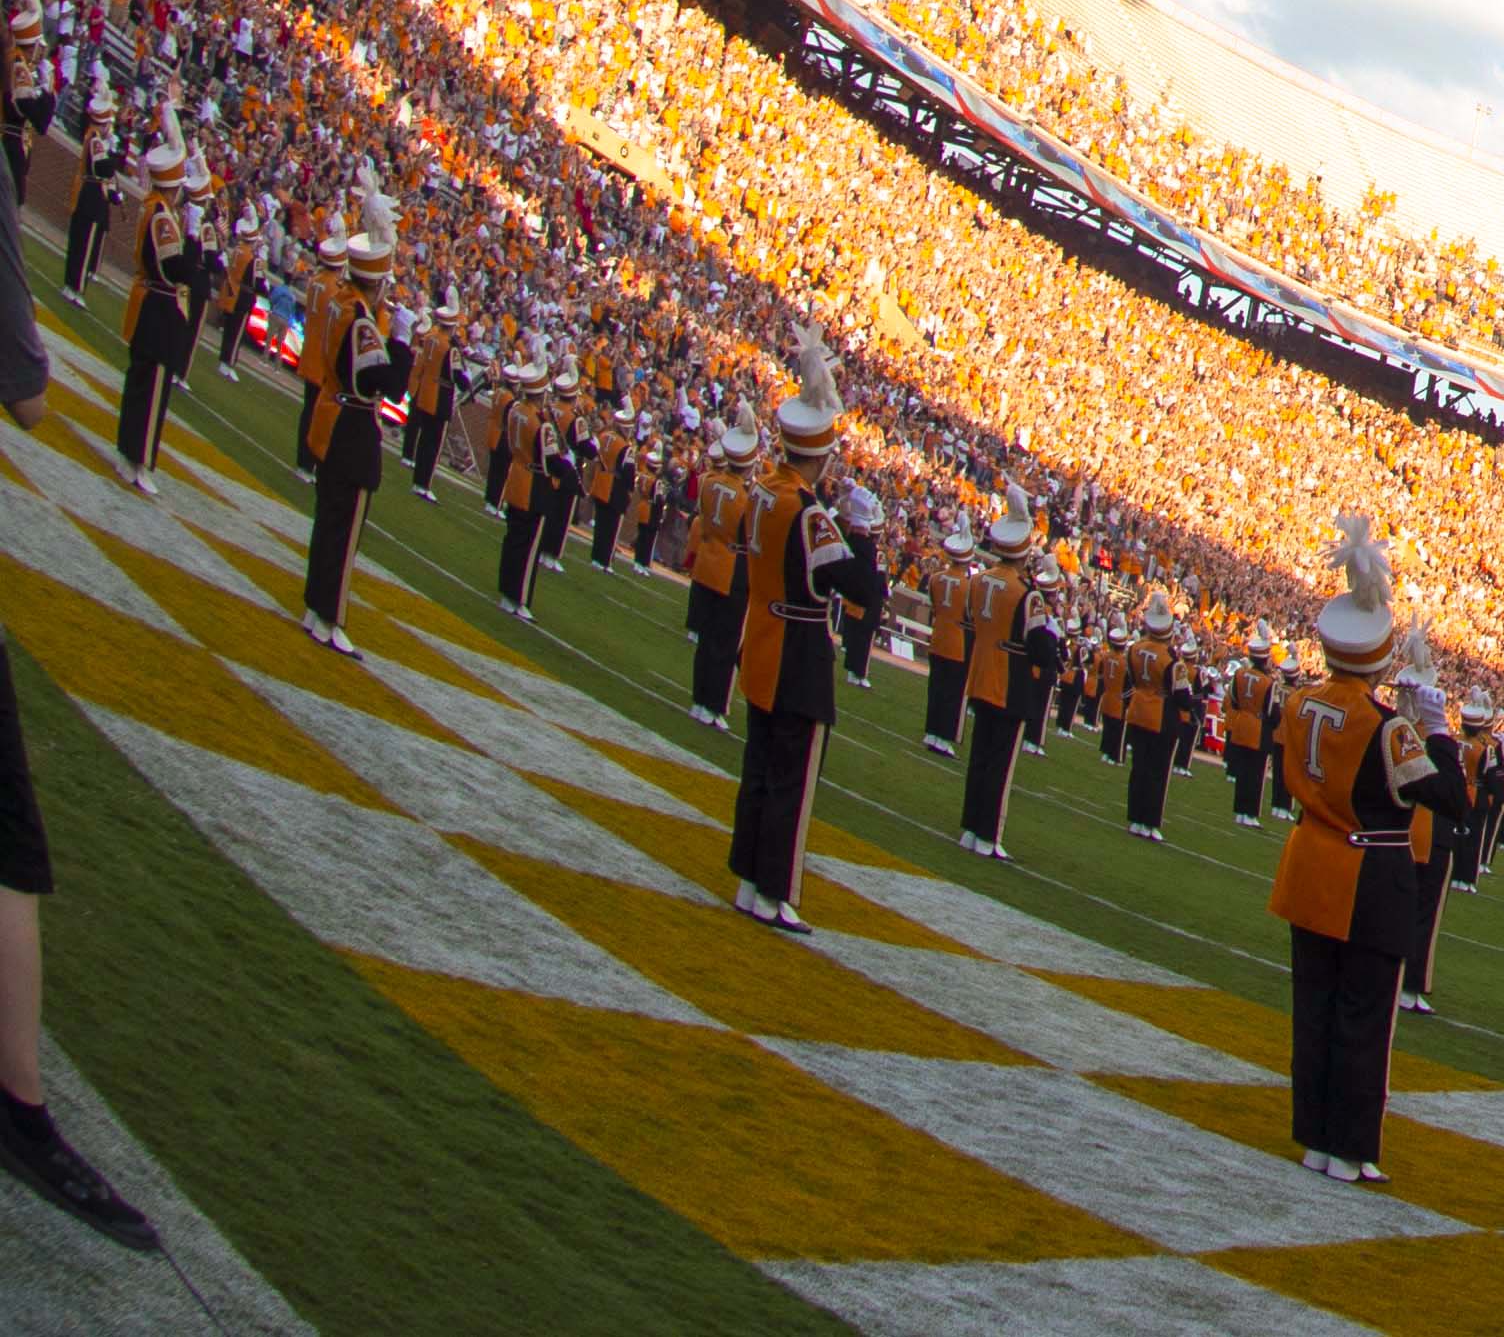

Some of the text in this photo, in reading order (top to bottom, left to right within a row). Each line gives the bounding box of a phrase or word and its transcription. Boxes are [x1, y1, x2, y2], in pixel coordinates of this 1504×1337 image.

[711, 484, 737, 527] T
[746, 485, 776, 556] T
[938, 575, 960, 608] T
[978, 574, 1007, 621] T
[1108, 658, 1119, 679] T
[1138, 649, 1158, 681] T
[1242, 671, 1260, 698] T
[1298, 696, 1345, 782] T
